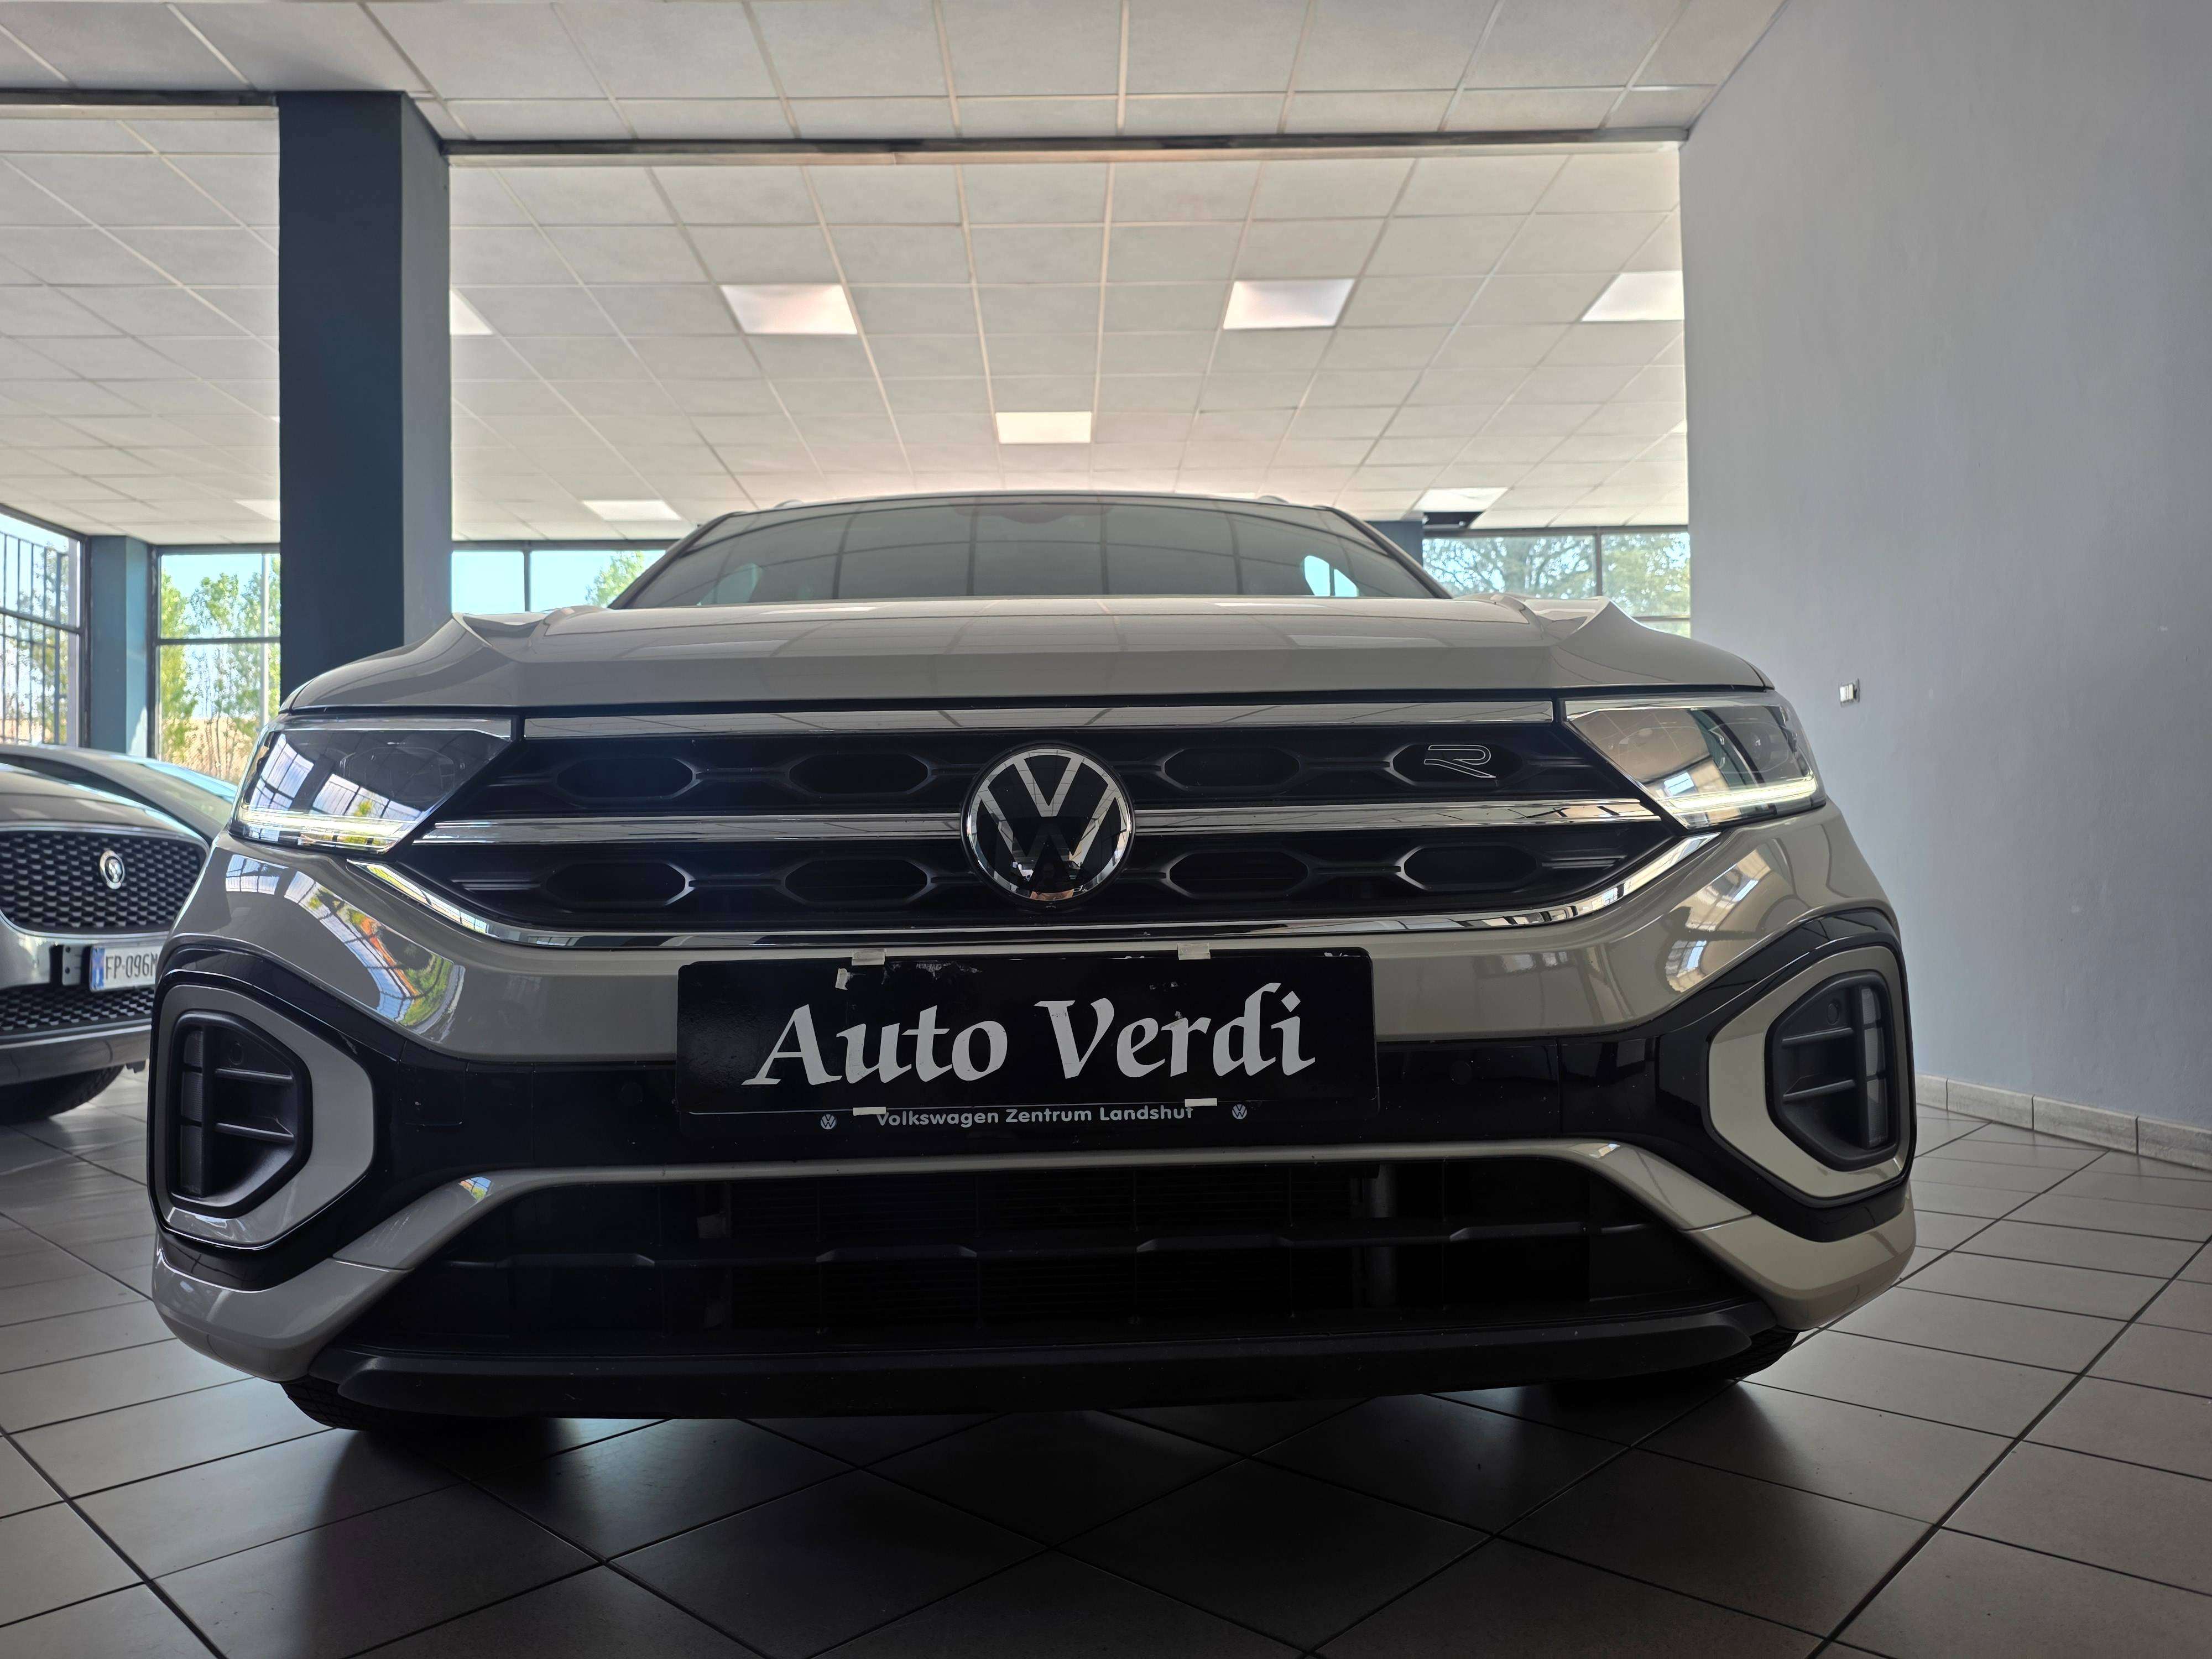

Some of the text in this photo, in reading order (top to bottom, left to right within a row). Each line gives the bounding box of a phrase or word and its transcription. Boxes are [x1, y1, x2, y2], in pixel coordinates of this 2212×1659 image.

[1423, 744, 1496, 778] R
[967, 748, 1133, 901] VW
[741, 982, 1316, 1086] Auto Verdi
[820, 1114, 837, 1130] VW
[877, 1105, 1194, 1128] Volkswagen Zentrum Landshut
[1232, 1104, 1248, 1120] VW
